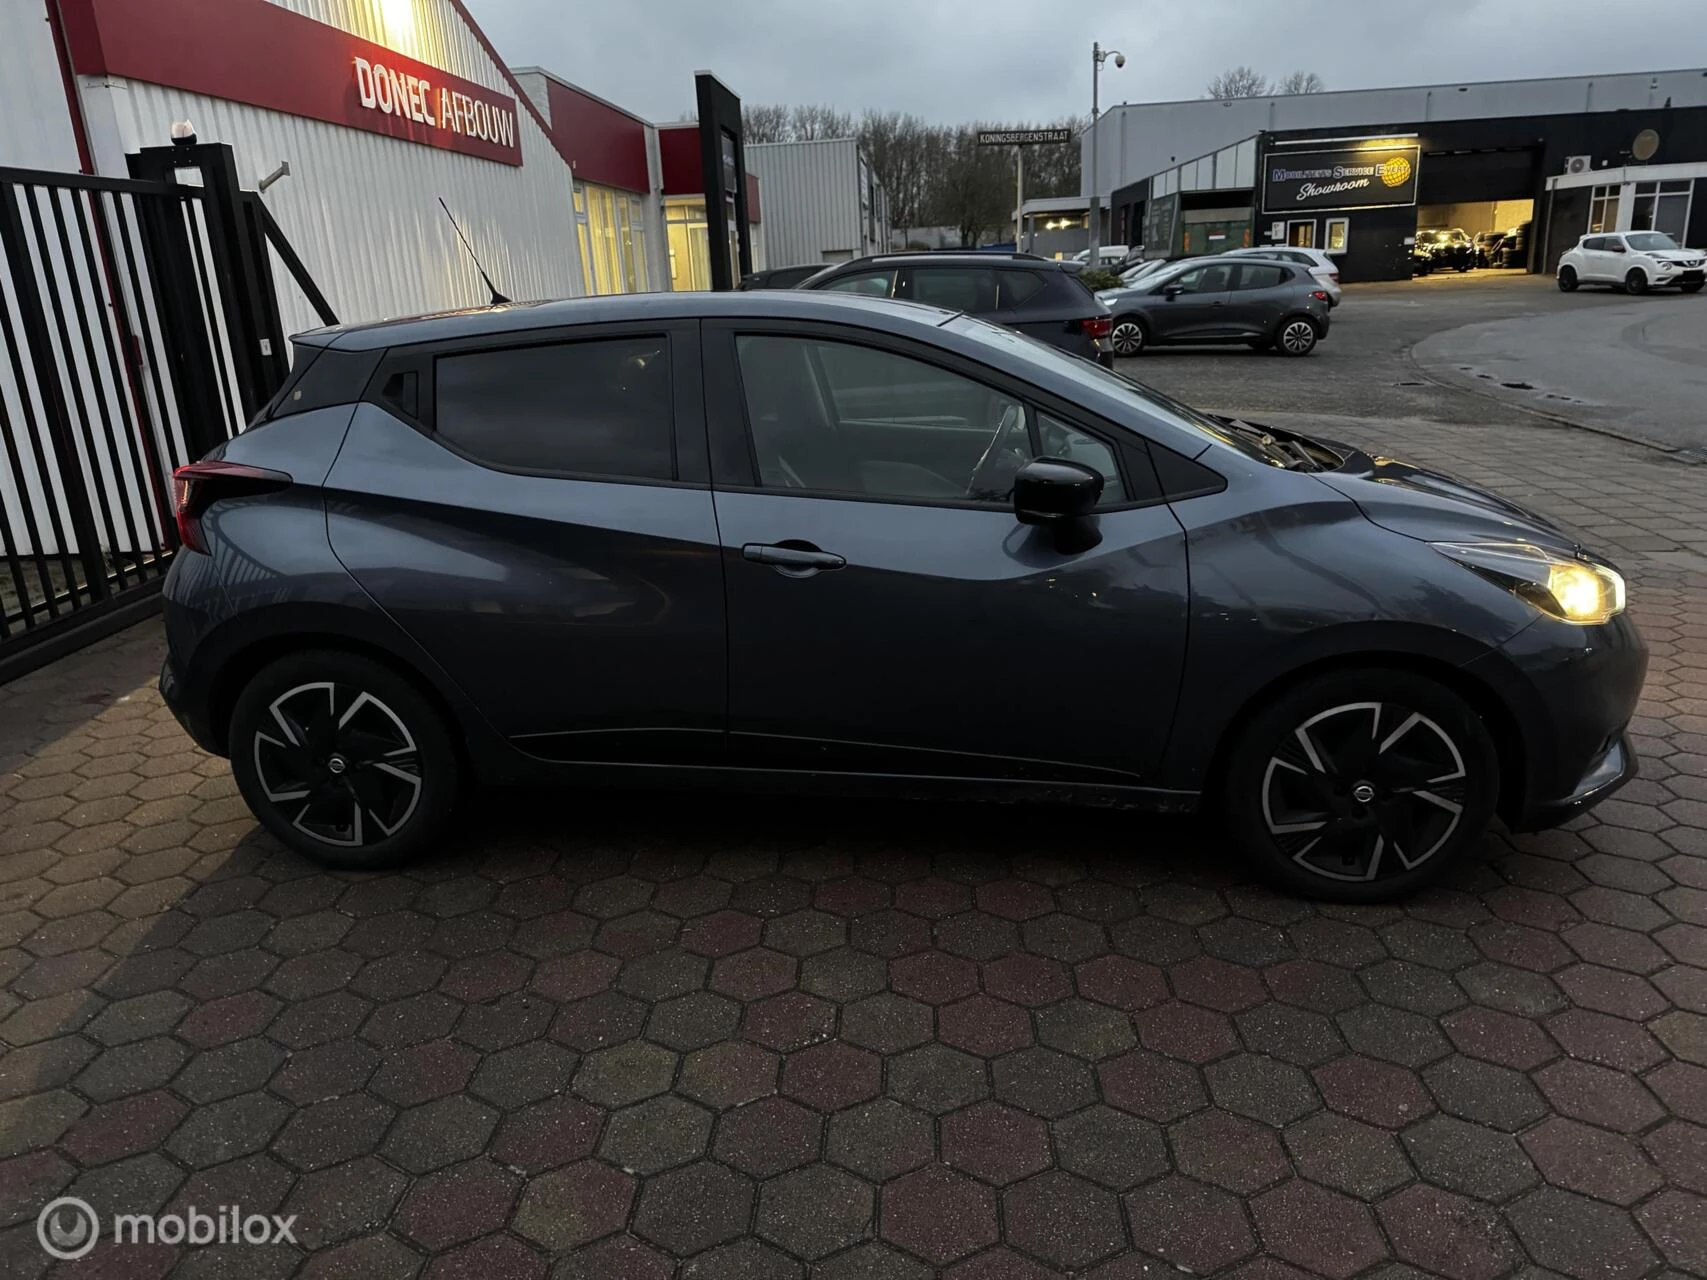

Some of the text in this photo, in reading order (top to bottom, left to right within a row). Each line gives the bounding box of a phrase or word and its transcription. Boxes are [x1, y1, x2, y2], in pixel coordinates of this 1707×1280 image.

[354, 56, 514, 148] DONEC AFBOUW
[1296, 178, 1370, 201] Showroom
